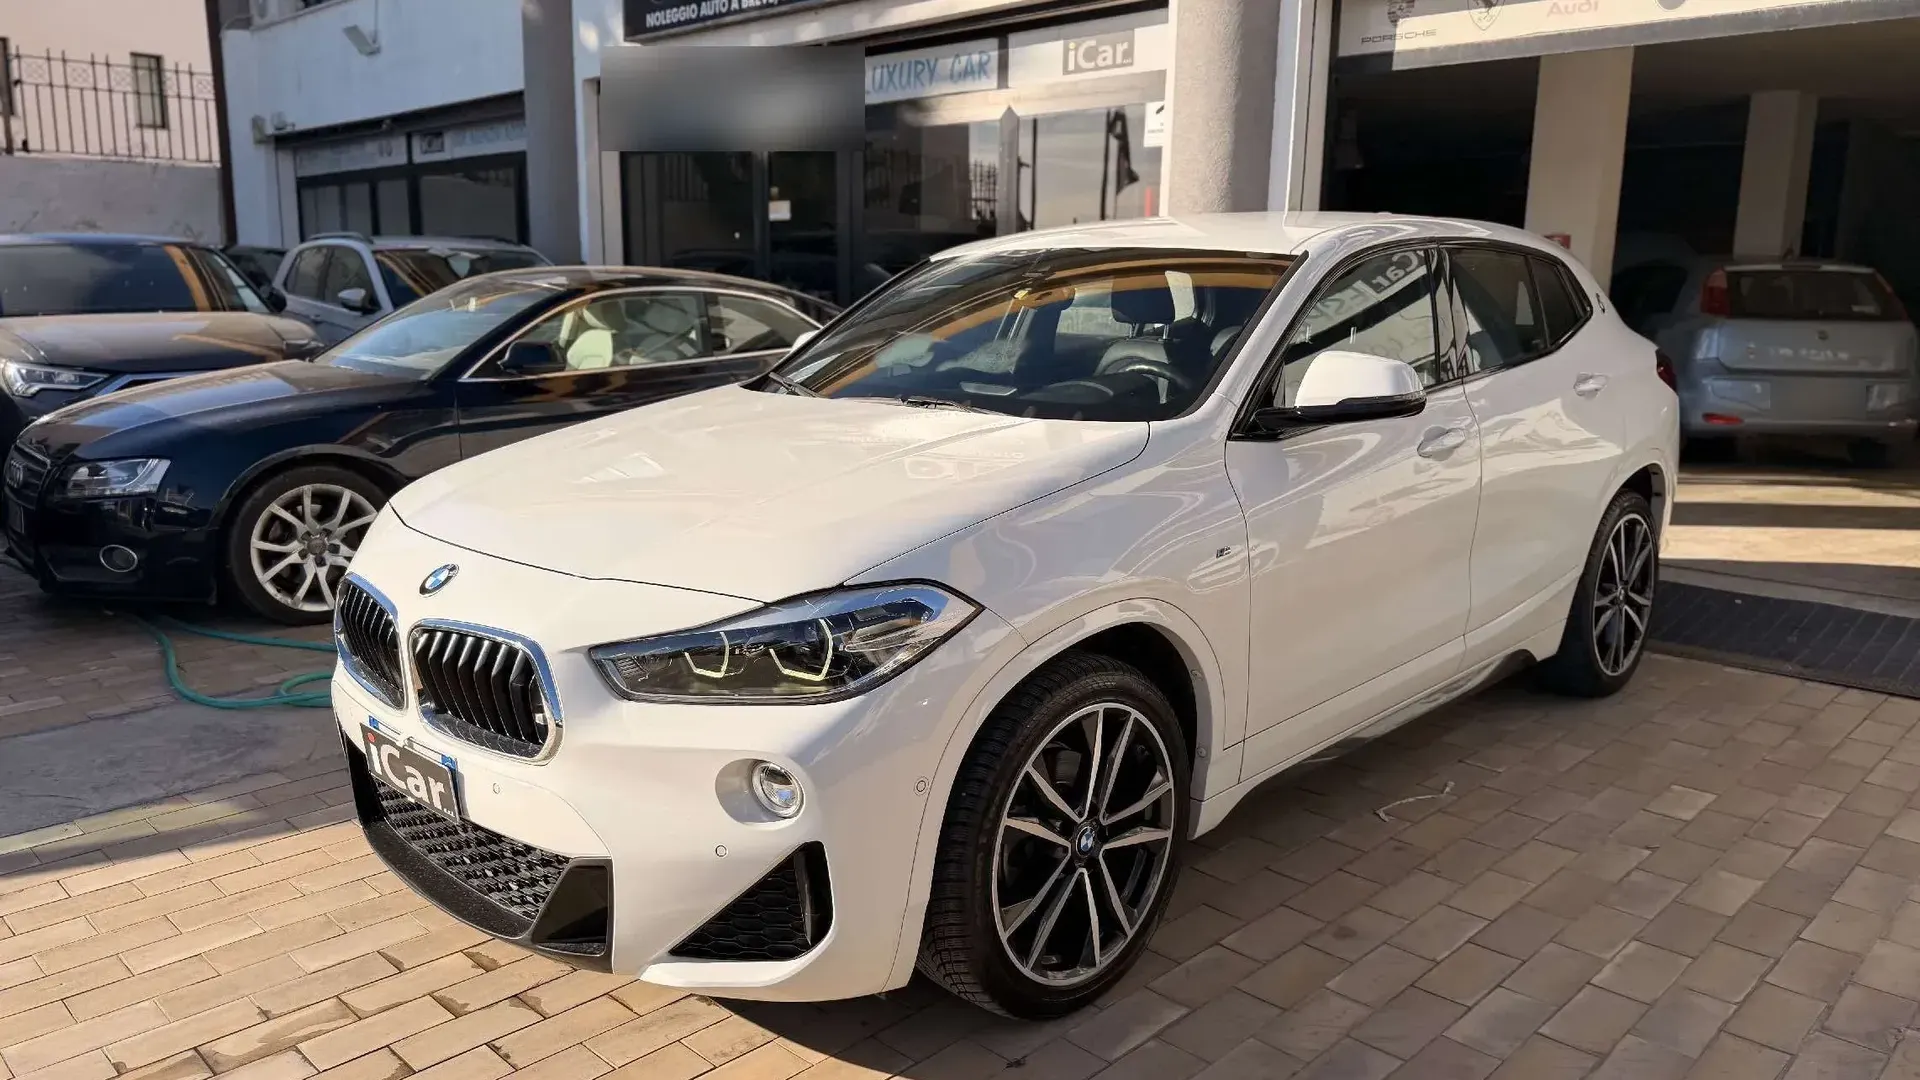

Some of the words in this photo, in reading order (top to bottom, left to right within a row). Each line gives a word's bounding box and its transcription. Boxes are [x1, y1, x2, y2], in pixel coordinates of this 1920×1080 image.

[646, 4, 698, 27] NOLEGGIO
[700, 1, 728, 16] AUTO
[731, 0, 739, 11] A
[1361, 29, 1437, 44] PORSCHE
[1067, 40, 1129, 71] iCar
[865, 57, 938, 95] UXURY
[950, 50, 990, 84] CAR
[367, 732, 445, 811] iCar
